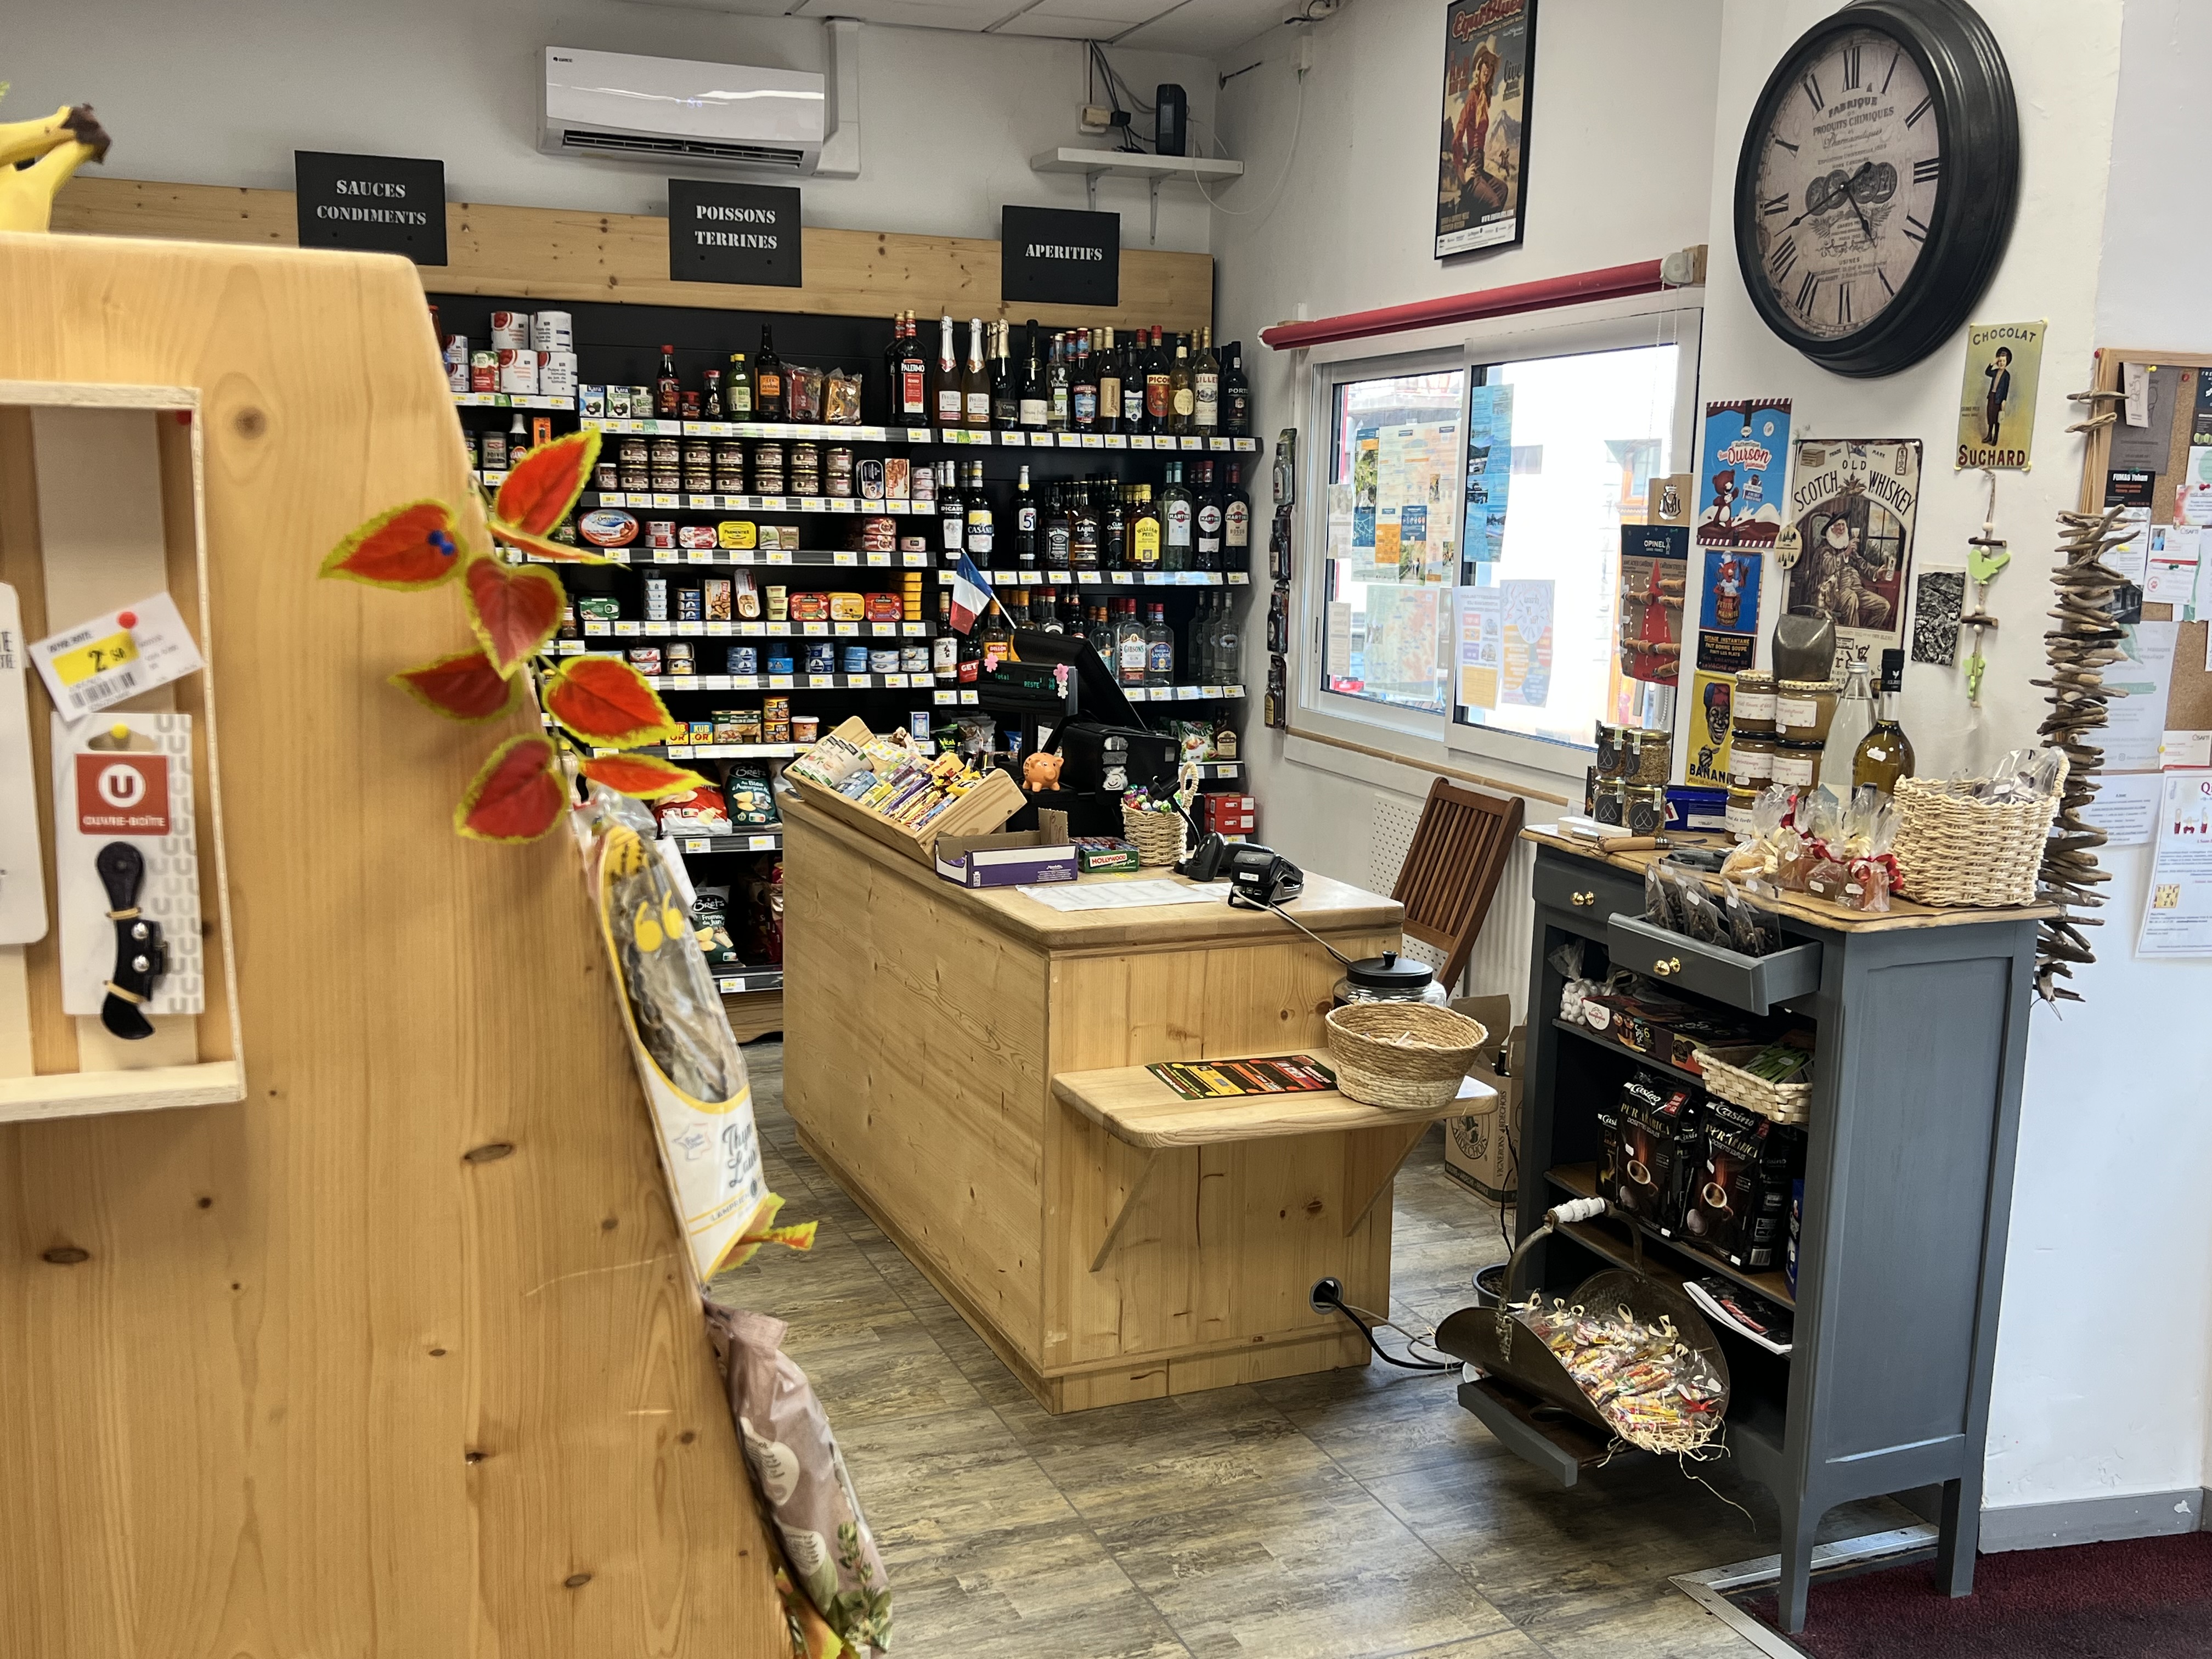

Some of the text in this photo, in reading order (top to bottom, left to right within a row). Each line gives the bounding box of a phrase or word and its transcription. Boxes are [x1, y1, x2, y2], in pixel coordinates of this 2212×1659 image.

[1828, 97, 1877, 119] FABRIQUE
[1813, 106, 1894, 136] PRODUITS CHIMIQUES
[336, 180, 406, 198] SAUCES
[317, 205, 426, 225] CONDIMENTS
[696, 205, 776, 224] POISSONS
[695, 230, 777, 250] TERRINES
[1025, 243, 1103, 262] APERITIFS
[1838, 257, 1860, 265] USINES
[1973, 328, 2036, 346] CHOCOLAT
[901, 363, 925, 373] PALERMO
[1728, 448, 1769, 464] Ourson
[1959, 444, 2025, 466] SUCHARD
[1842, 460, 1866, 470] OLD
[1794, 470, 1838, 512] SCOTCH
[1869, 470, 1915, 516] WHISKEY
[1023, 515, 1035, 528] 51
[1644, 540, 1666, 548] OPINEL
[961, 663, 977, 672] GET
[693, 725, 710, 733] KUB
[1690, 763, 1729, 784] BANANI
[111, 775, 133, 799] U
[1092, 854, 1126, 865] HOLLYWOOD
[1644, 1028, 1651, 1038] 6
[1630, 1084, 1661, 1106] Casino
[1602, 1114, 1618, 1126] Casi
[1621, 1103, 1670, 1135] PUR ARABICA
[1715, 1102, 1754, 1127] Casino
[1497, 1135, 1505, 1177] VIGNERONS
